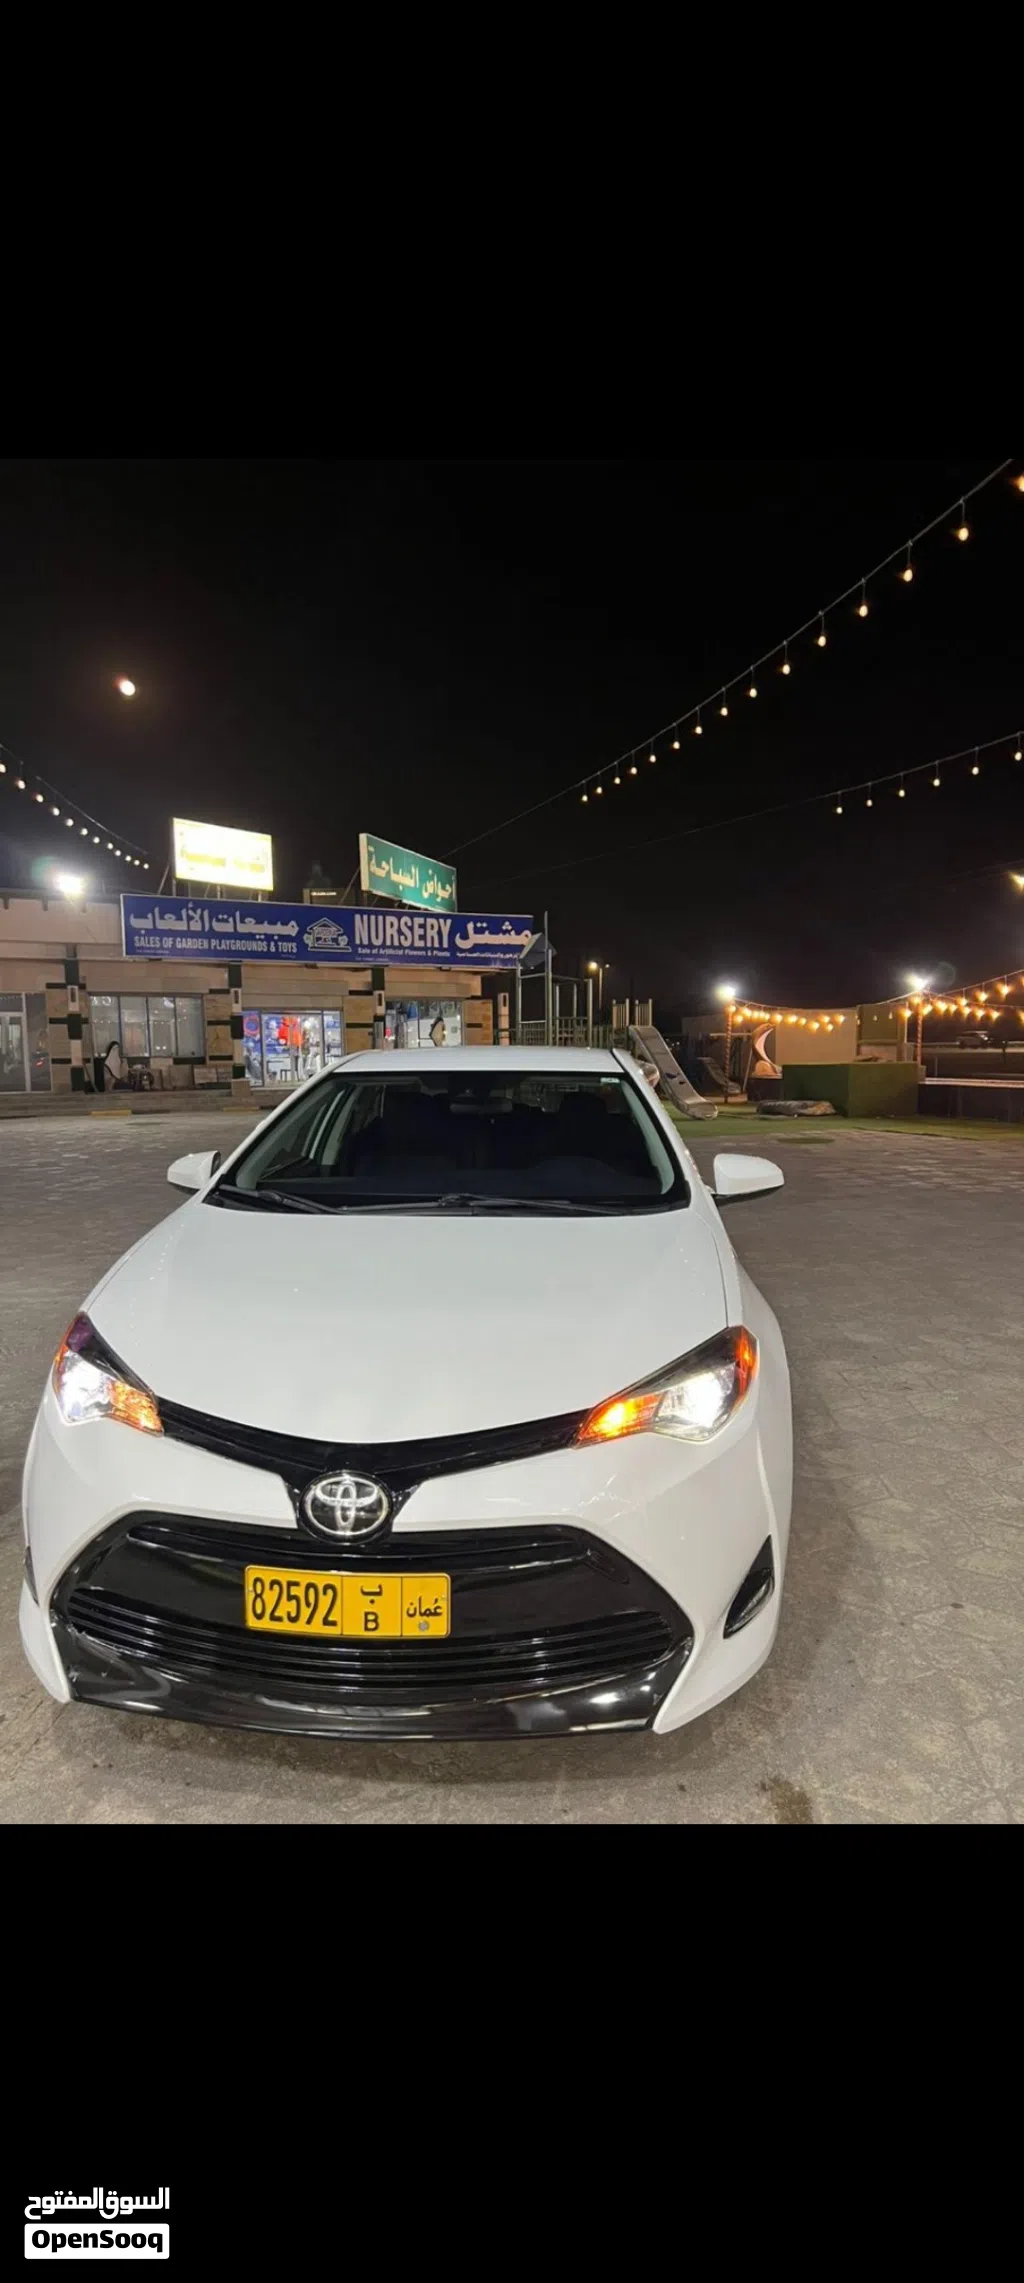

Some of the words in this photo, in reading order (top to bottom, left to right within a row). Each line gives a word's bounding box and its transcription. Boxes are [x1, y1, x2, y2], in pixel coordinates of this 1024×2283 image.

[368, 845, 419, 891] السباحة
[129, 901, 210, 935] الألعاب
[212, 910, 299, 940] مبيعات
[354, 914, 452, 948] NURSERY
[134, 936, 161, 948] SALES
[162, 937, 174, 948] OF
[175, 937, 209, 950] GARDEN
[210, 939, 268, 952] PLAYGROUNDS
[269, 941, 276, 952] &
[277, 942, 297, 954] TOYS
[455, 921, 531, 949] مشتل
[252, 1577, 338, 1627] 82592
[360, 1584, 383, 1604] ب
[363, 1611, 379, 1632] B
